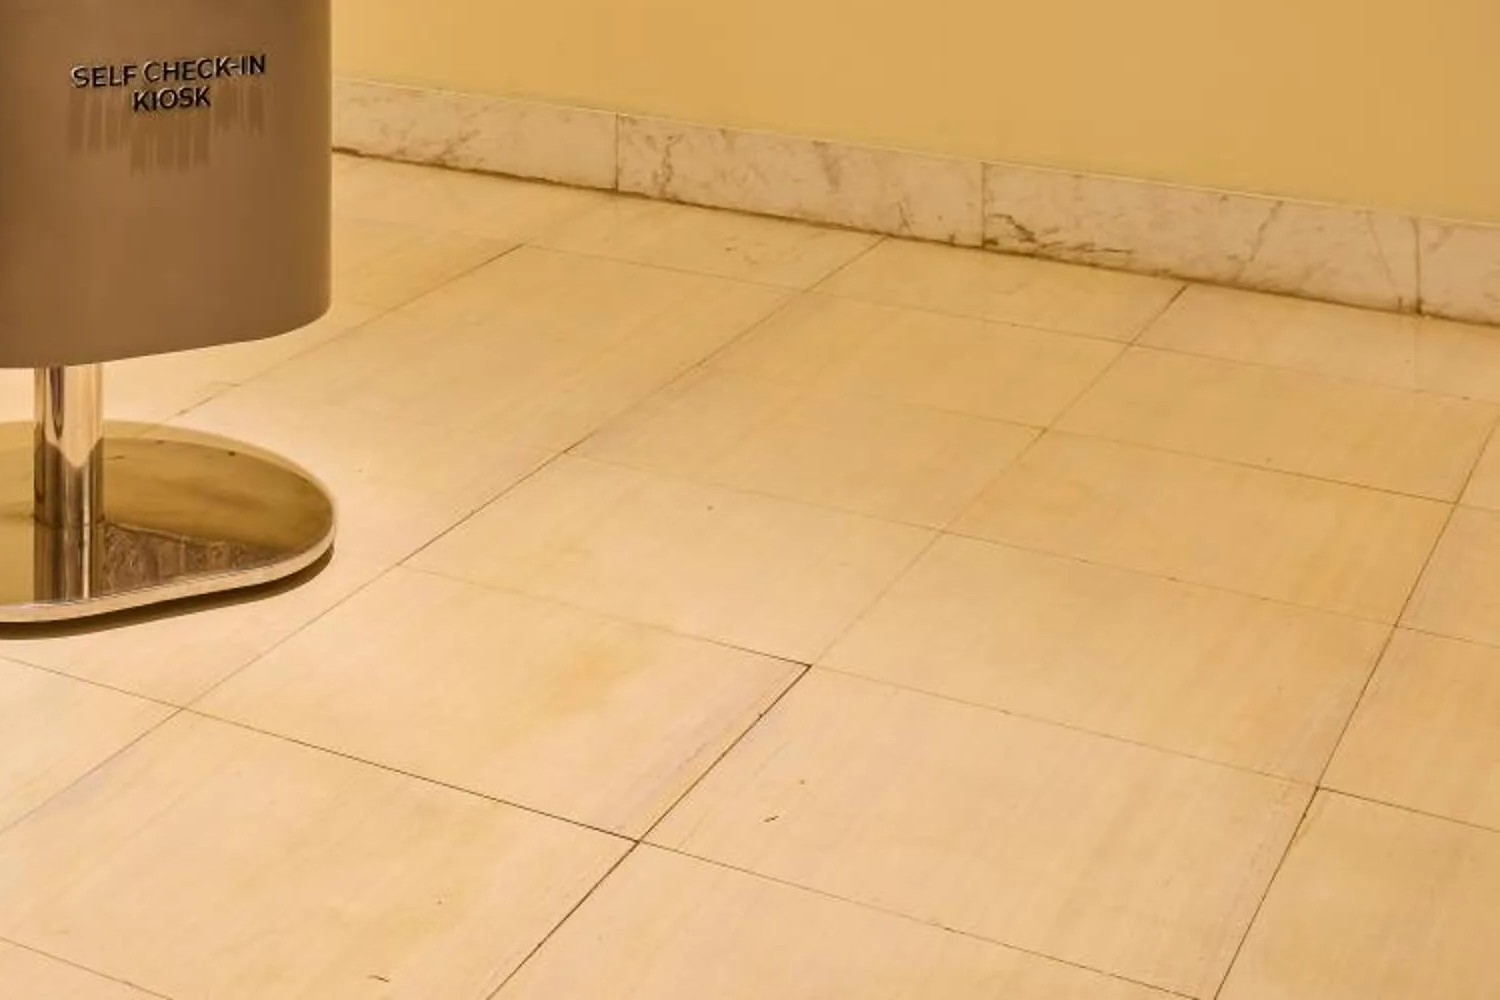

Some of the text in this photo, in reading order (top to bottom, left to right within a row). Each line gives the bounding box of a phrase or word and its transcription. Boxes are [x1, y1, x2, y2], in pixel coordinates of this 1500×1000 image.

[71, 54, 267, 89] SELF CHECK-IN
[132, 85, 212, 113] KIOSK
